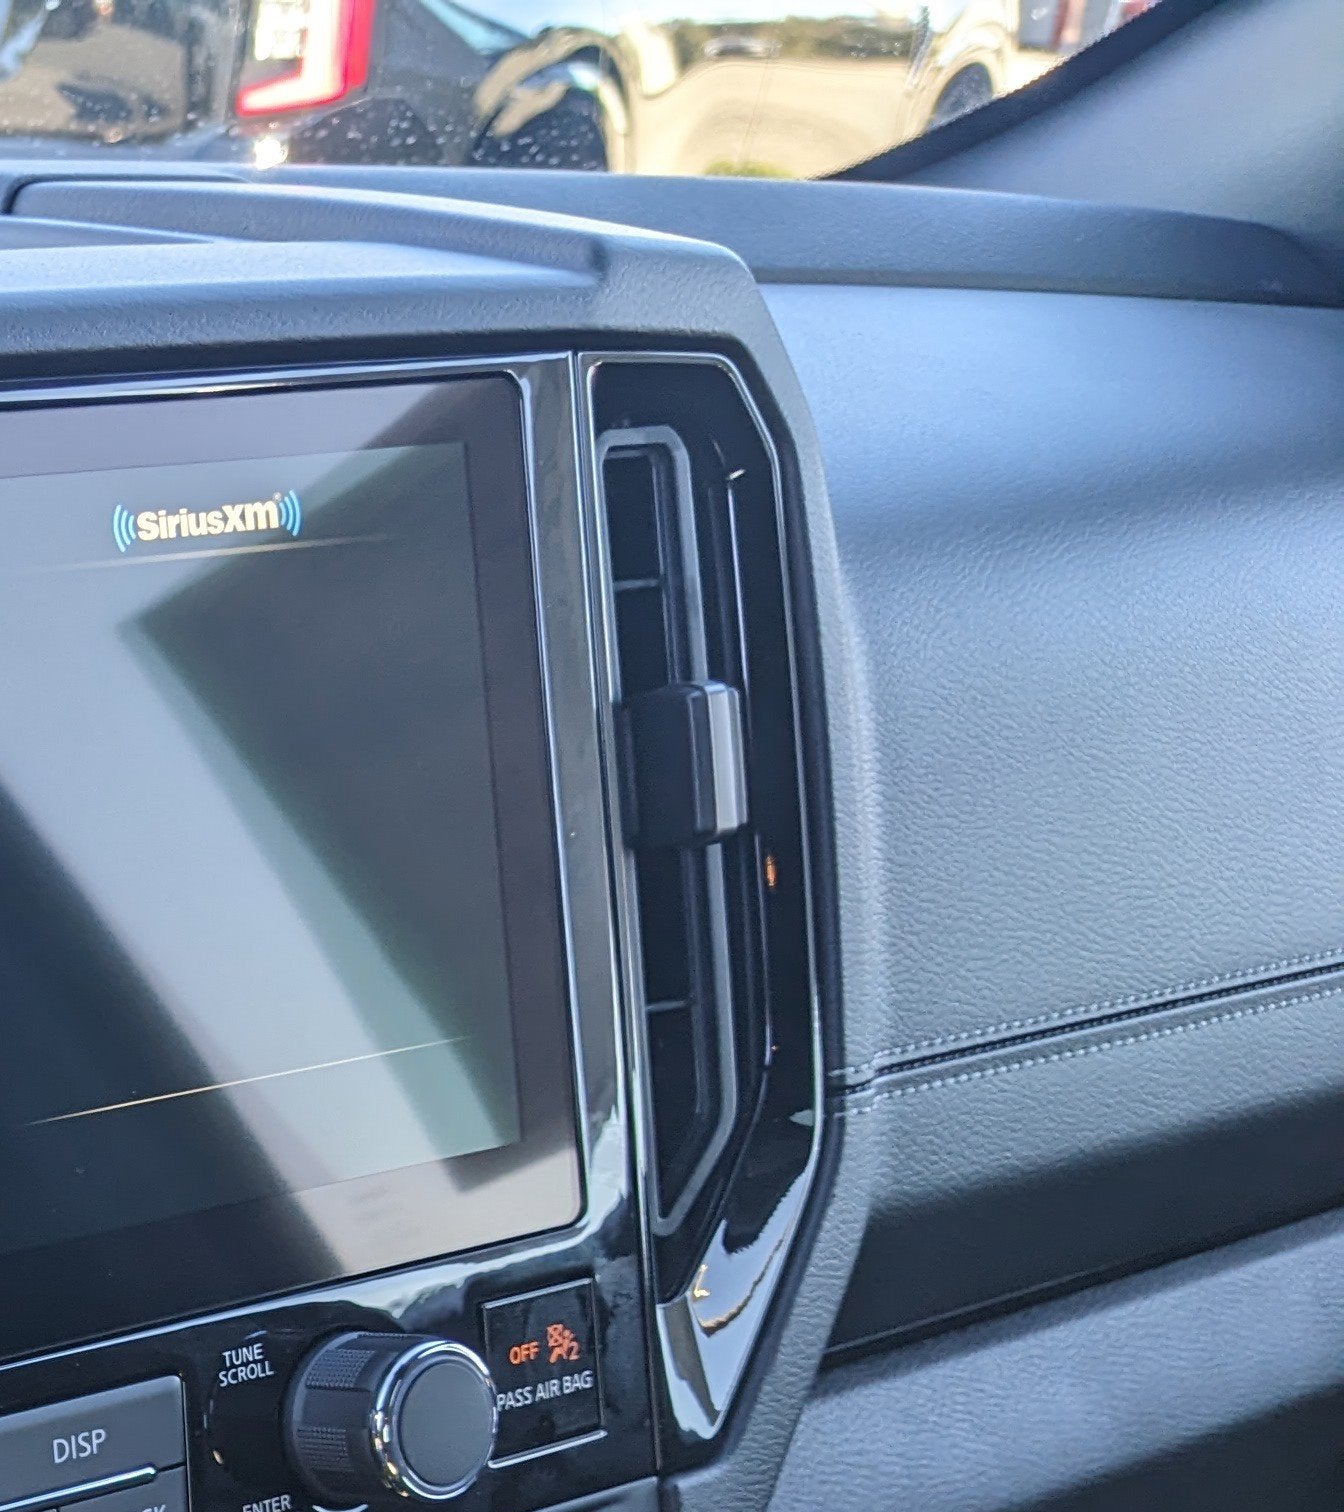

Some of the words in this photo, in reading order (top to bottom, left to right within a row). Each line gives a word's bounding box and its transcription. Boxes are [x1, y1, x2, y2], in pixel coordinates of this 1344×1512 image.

[221, 1342, 266, 1368] TUNE
[508, 1340, 540, 1365] OFF
[218, 1358, 275, 1389] SCROLL
[495, 1385, 534, 1412] PASS
[534, 1378, 562, 1402] AIR
[561, 1369, 594, 1395] BAG
[52, 1427, 109, 1465] DISP
